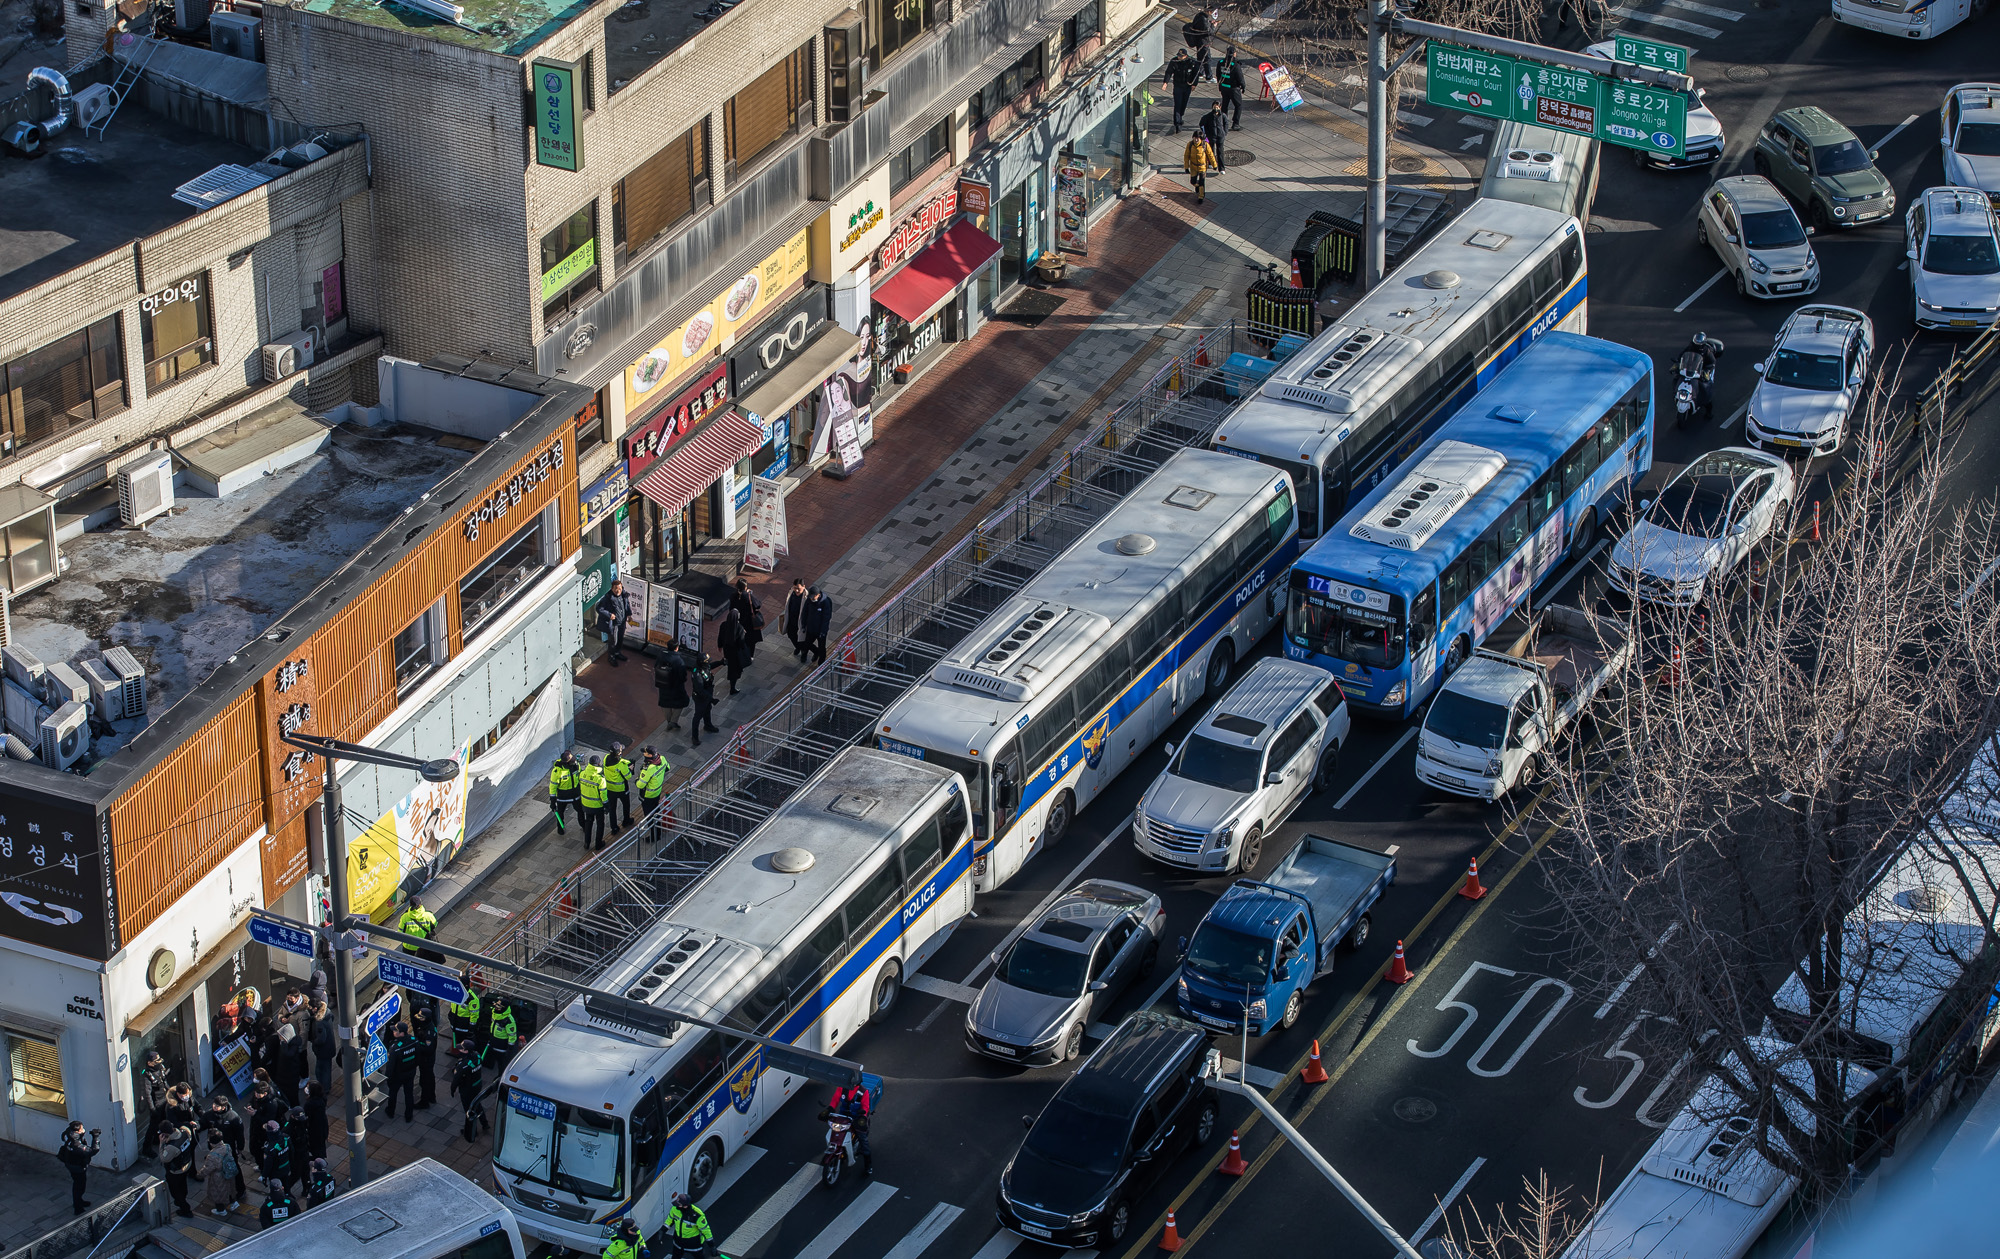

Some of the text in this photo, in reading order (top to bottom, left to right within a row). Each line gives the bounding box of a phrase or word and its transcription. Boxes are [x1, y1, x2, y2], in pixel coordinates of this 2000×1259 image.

[1436, 52, 1502, 78] 헌법재판소
[1623, 43, 1678, 67] 안국역
[1435, 69, 1502, 92] Constitutional Court
[1537, 70, 1589, 93] 흥인지문
[1520, 88, 1532, 99] 50
[547, 95, 562, 135] 삼선당
[1540, 99, 1570, 115] 창덕궁
[1611, 106, 1639, 121] Jongno
[1539, 112, 1592, 131] Changdeokgung
[1612, 126, 1635, 137] 삼일로
[541, 136, 571, 154] 한의원
[1659, 134, 1669, 147] 6
[882, 190, 959, 271] 헤비스테이크
[548, 242, 593, 285] 삼선당 한의원
[141, 278, 201, 317] 한의원
[1531, 307, 1558, 340] POLICE
[880, 317, 942, 384] HEAVY STEAK
[769, 456, 787, 476] ACUVUE
[1580, 477, 1595, 502] 171
[1235, 569, 1266, 607] POLICE
[1290, 646, 1305, 659] 171
[1048, 754, 1069, 782] 경찰
[355, 856, 391, 887] coming
[0, 873, 84, 900] EONGSEONGSIK
[354, 877, 379, 899] soon
[902, 881, 936, 925] POLICE
[268, 936, 311, 956] Bukchon-ro
[278, 927, 311, 947] 북촌로
[381, 960, 426, 982] 삼일대로
[382, 971, 427, 992] Samil-daero
[66, 1003, 103, 1021] BOTEA
[73, 994, 95, 1007] cafe
[1406, 960, 1574, 1078] 50
[521, 1096, 554, 1112] 서울기동경찰
[693, 1100, 716, 1130] 경찰
